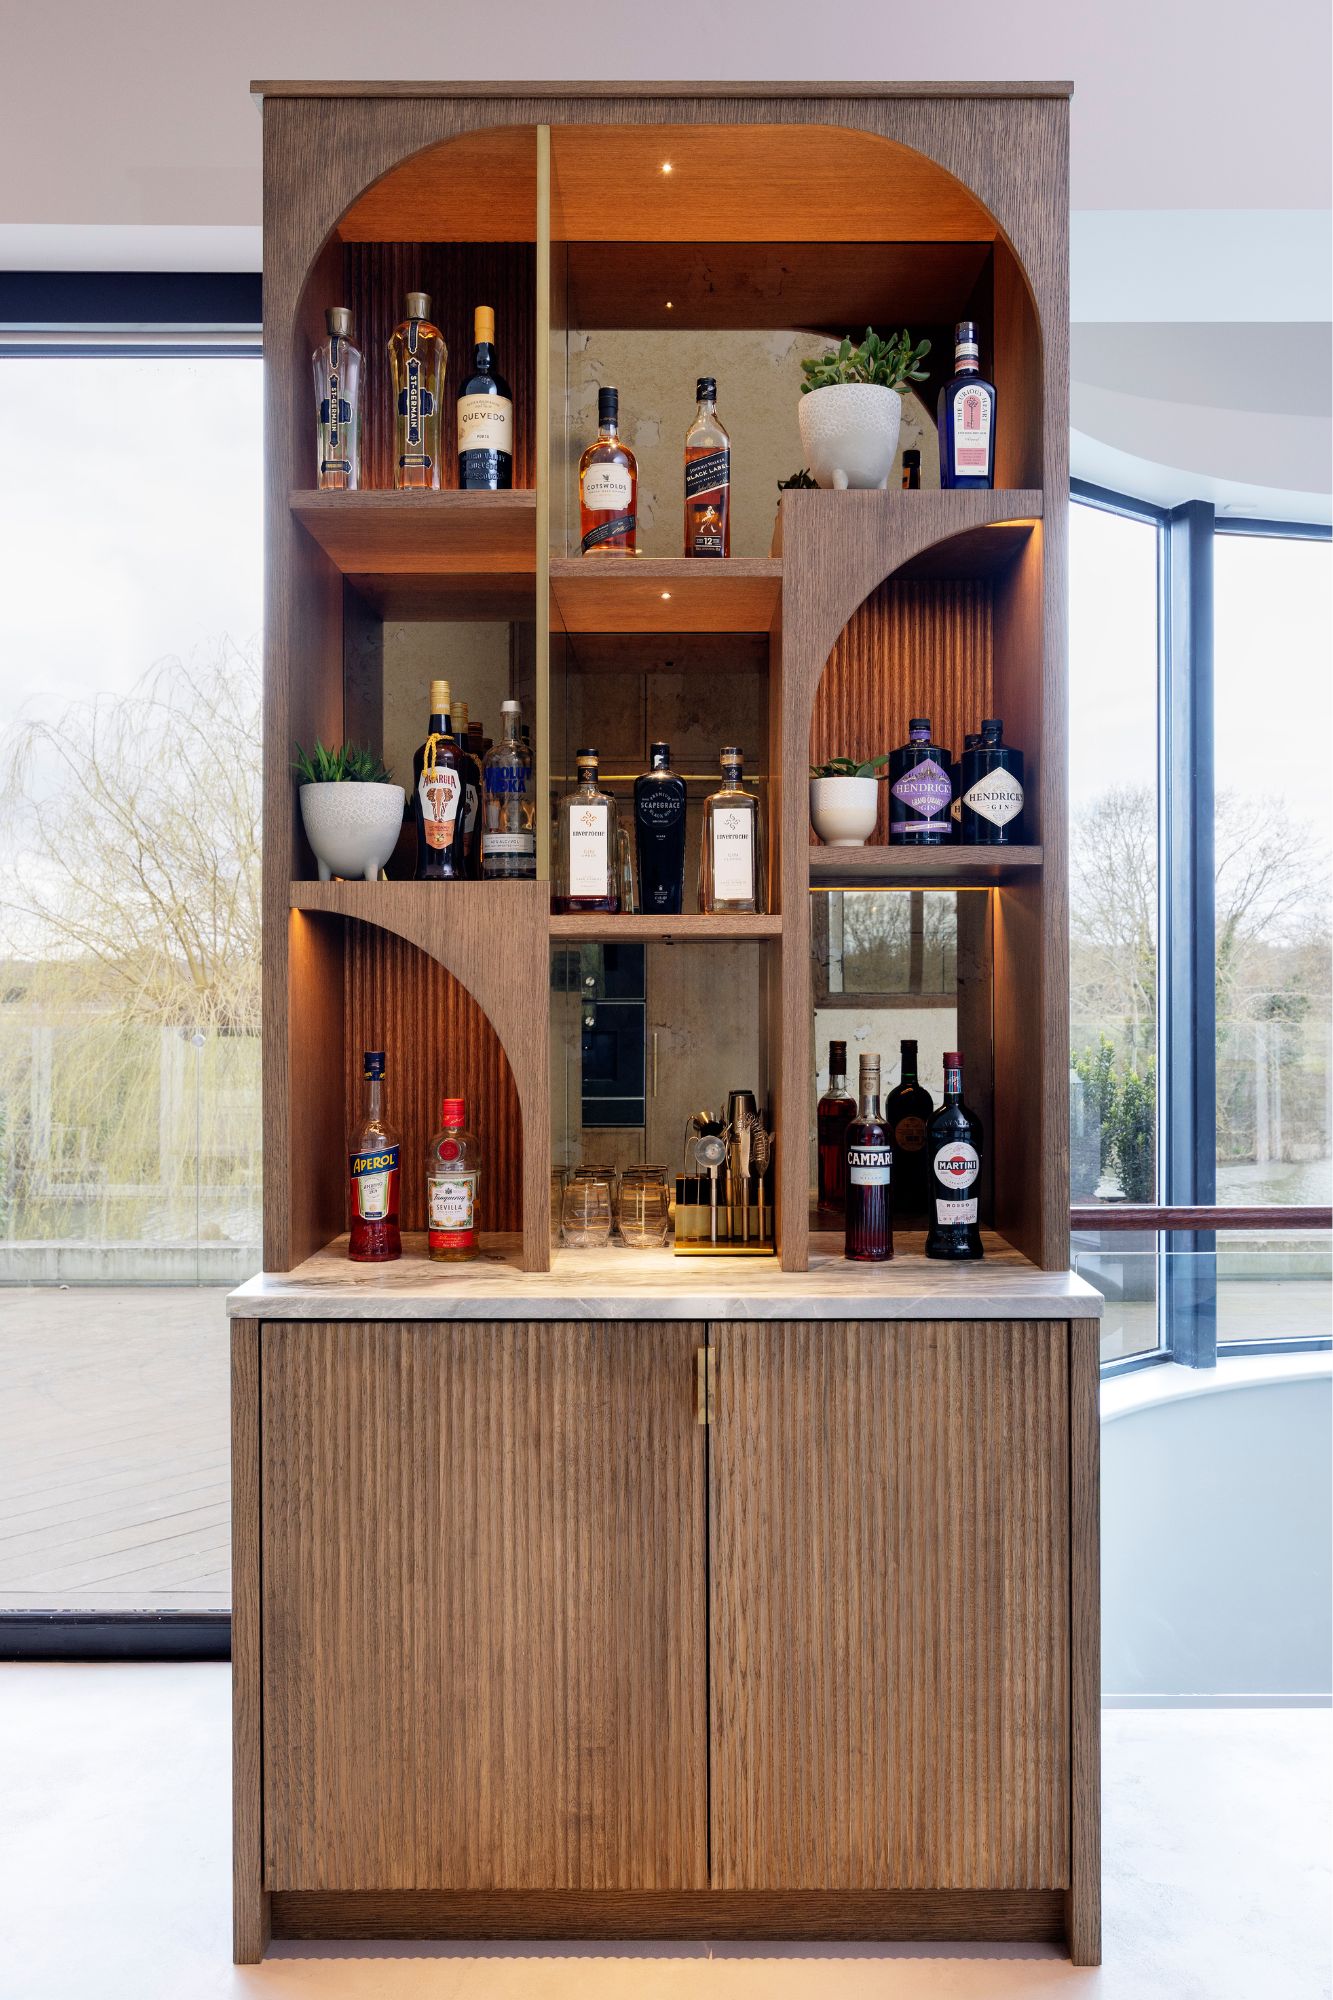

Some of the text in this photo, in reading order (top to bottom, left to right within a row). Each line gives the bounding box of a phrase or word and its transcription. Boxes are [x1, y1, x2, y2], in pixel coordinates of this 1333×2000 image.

[410, 375, 418, 428] ST-GERMAIN
[462, 412, 505, 422] QUEVEDO
[686, 470, 708, 482] BLACK
[708, 463, 730, 474] LABEL
[586, 483, 627, 491] COTSWOLDS
[703, 537, 713, 545] 12
[353, 1153, 395, 1174] APEROL
[939, 1161, 976, 1170] MARTINI
